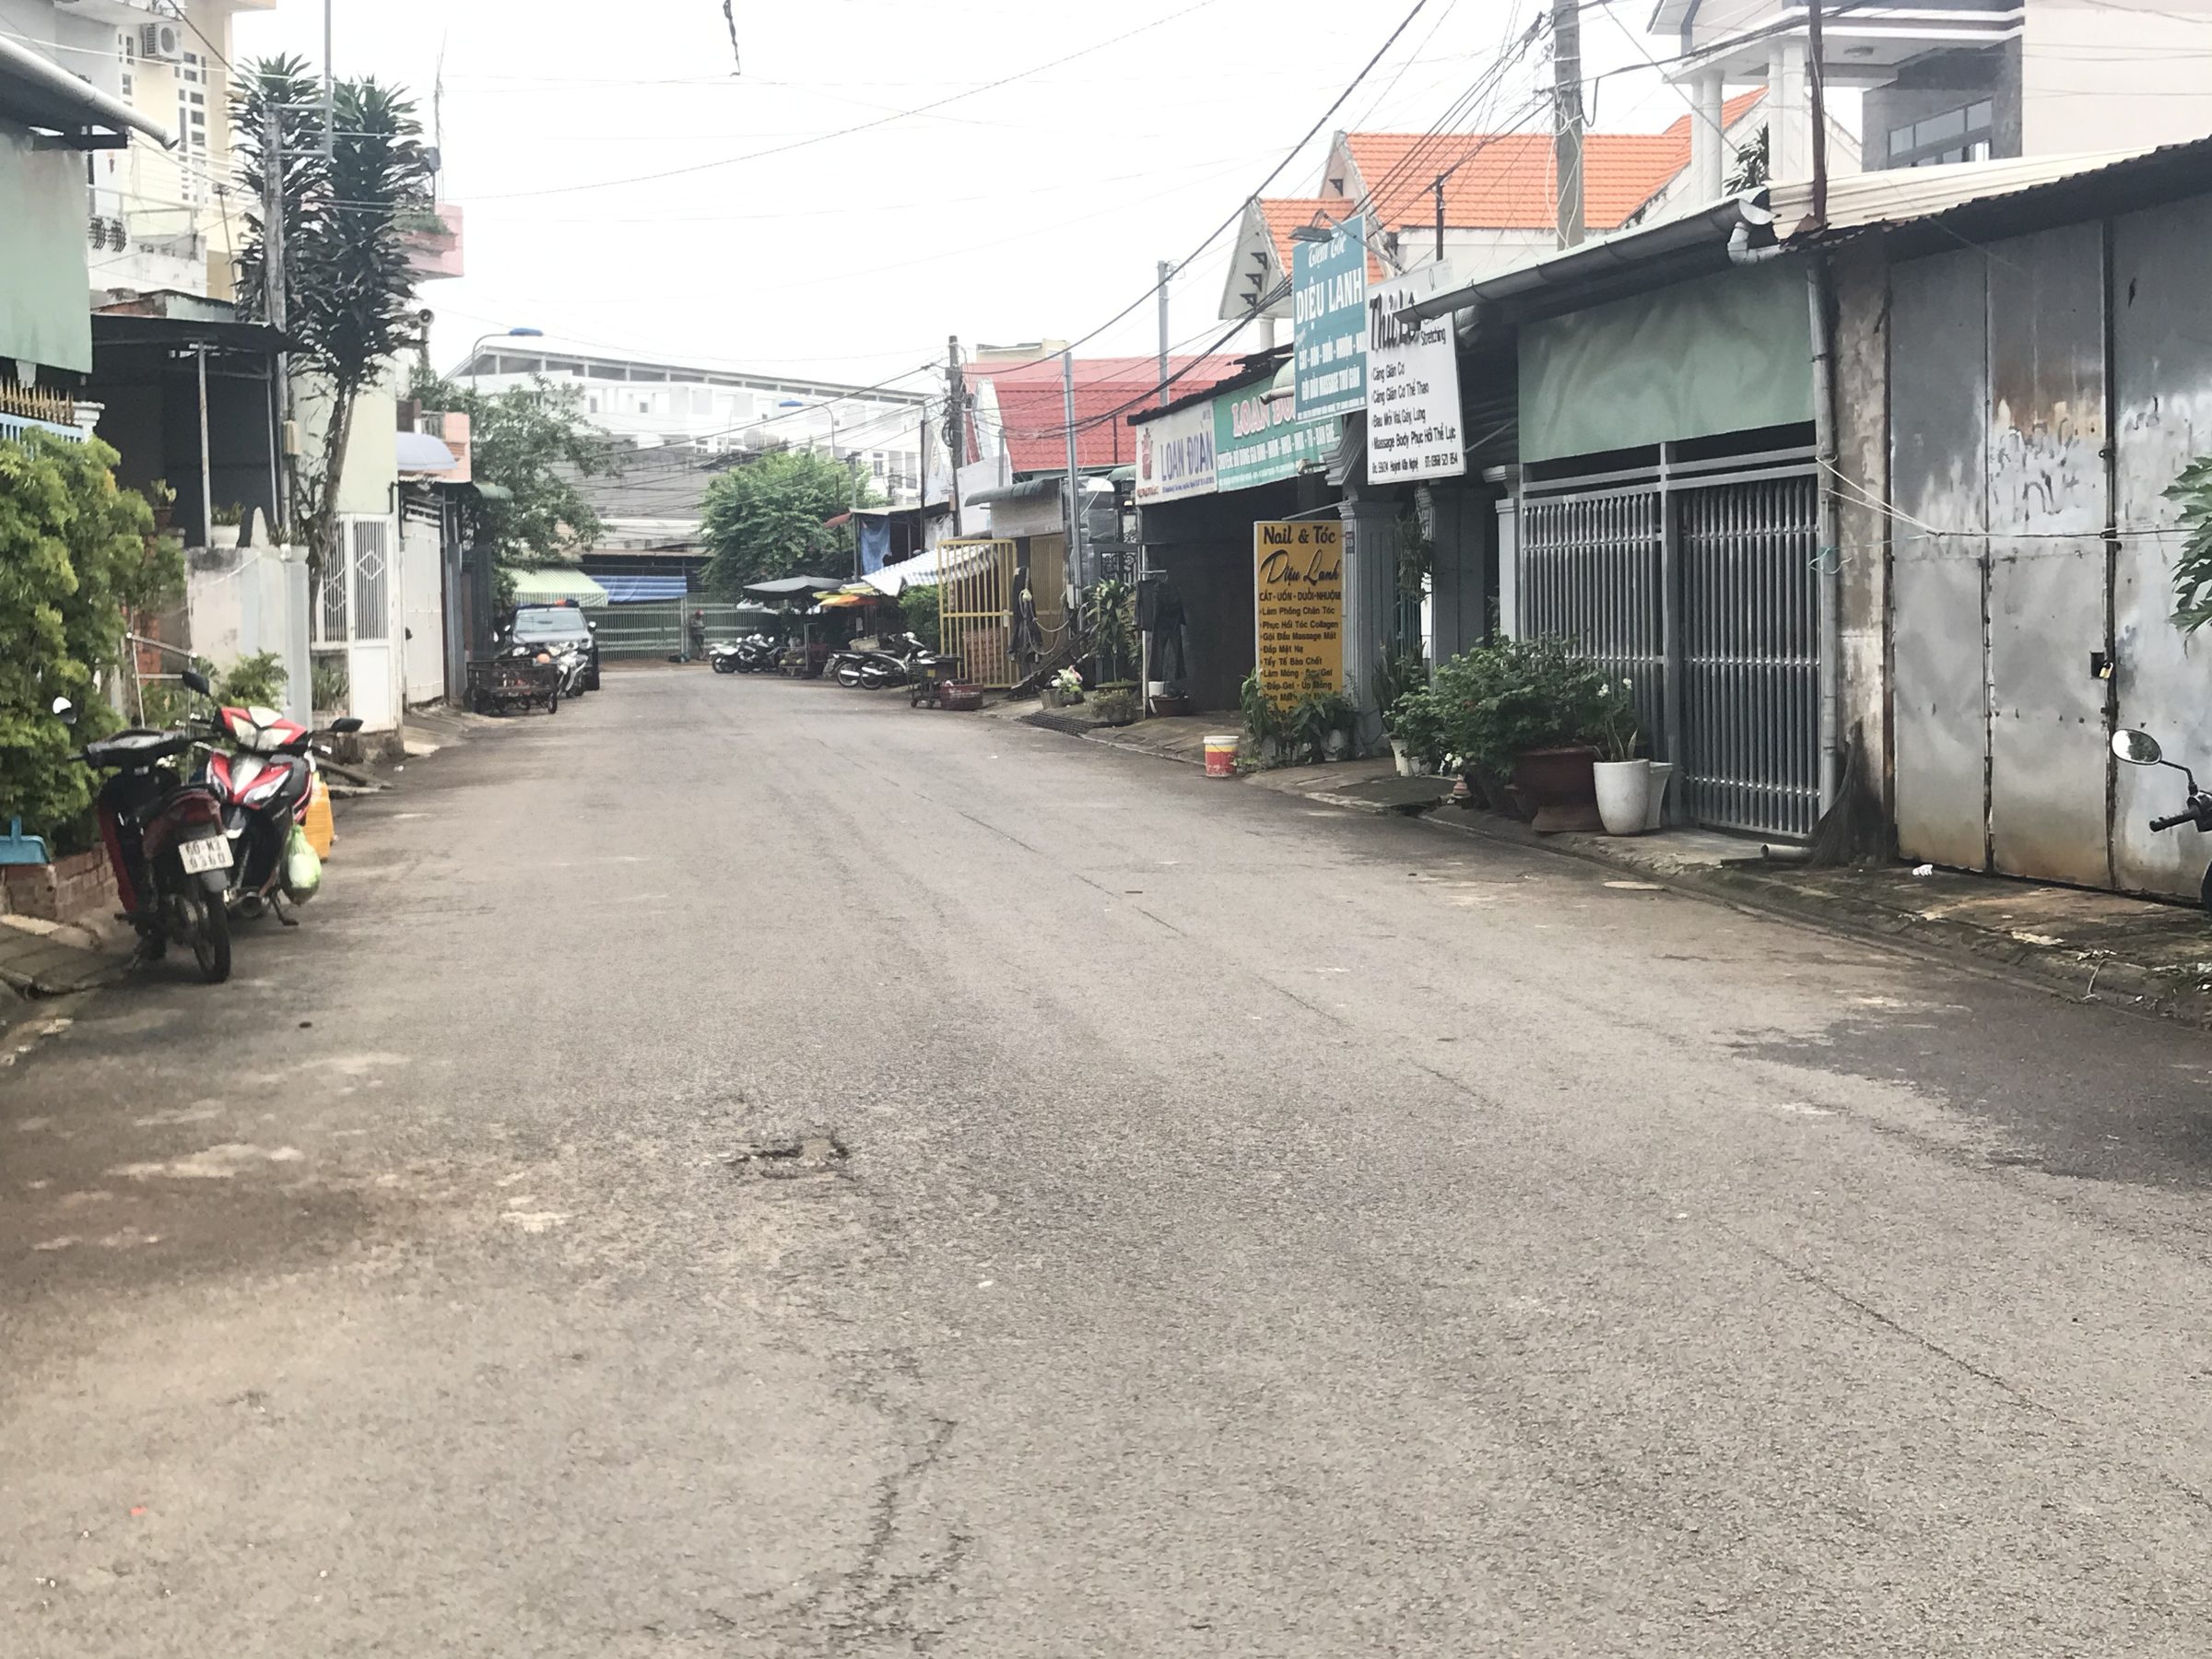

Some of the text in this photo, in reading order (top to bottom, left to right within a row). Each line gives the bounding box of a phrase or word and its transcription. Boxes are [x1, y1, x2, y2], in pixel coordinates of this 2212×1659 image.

[1296, 267, 1363, 330] DIỆU LANH
[1417, 381, 1430, 394] Thao
[1231, 396, 1270, 438] LOAN
[1373, 436, 1394, 452] Massage
[1395, 432, 1409, 449] Body
[1410, 430, 1423, 448] Phục
[1160, 438, 1185, 481] LOAN
[1186, 420, 1214, 476] ĐOÀN
[1264, 524, 1294, 545] Nail
[1298, 528, 1310, 544] &
[1312, 524, 1336, 544] Tóc
[1260, 548, 1340, 586] Diệu Lanh
[1323, 606, 1335, 615] Tóc
[1295, 619, 1308, 629] Tóc
[1310, 620, 1339, 629] Collagen
[1292, 632, 1322, 641] Massage
[1320, 668, 1333, 677] Gel
[1282, 681, 1295, 690] Gel
